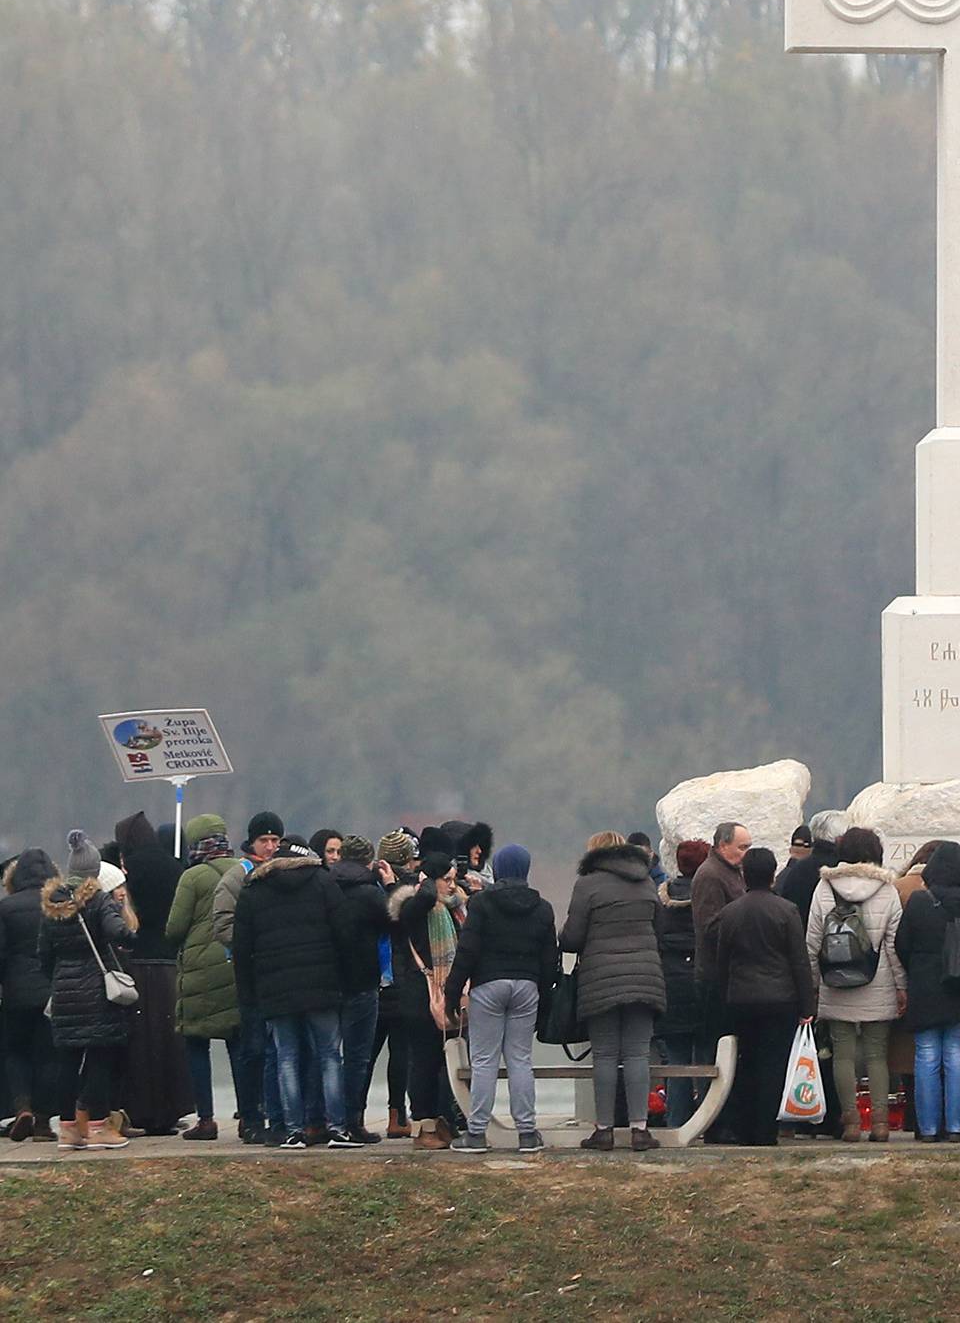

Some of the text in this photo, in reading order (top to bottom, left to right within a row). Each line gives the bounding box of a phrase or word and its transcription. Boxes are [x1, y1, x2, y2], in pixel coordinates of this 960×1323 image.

[162, 727, 207, 738] Sv. Ilije
[165, 737, 213, 748] proroka
[163, 748, 213, 760] Metković
[166, 758, 218, 769] CROATIA
